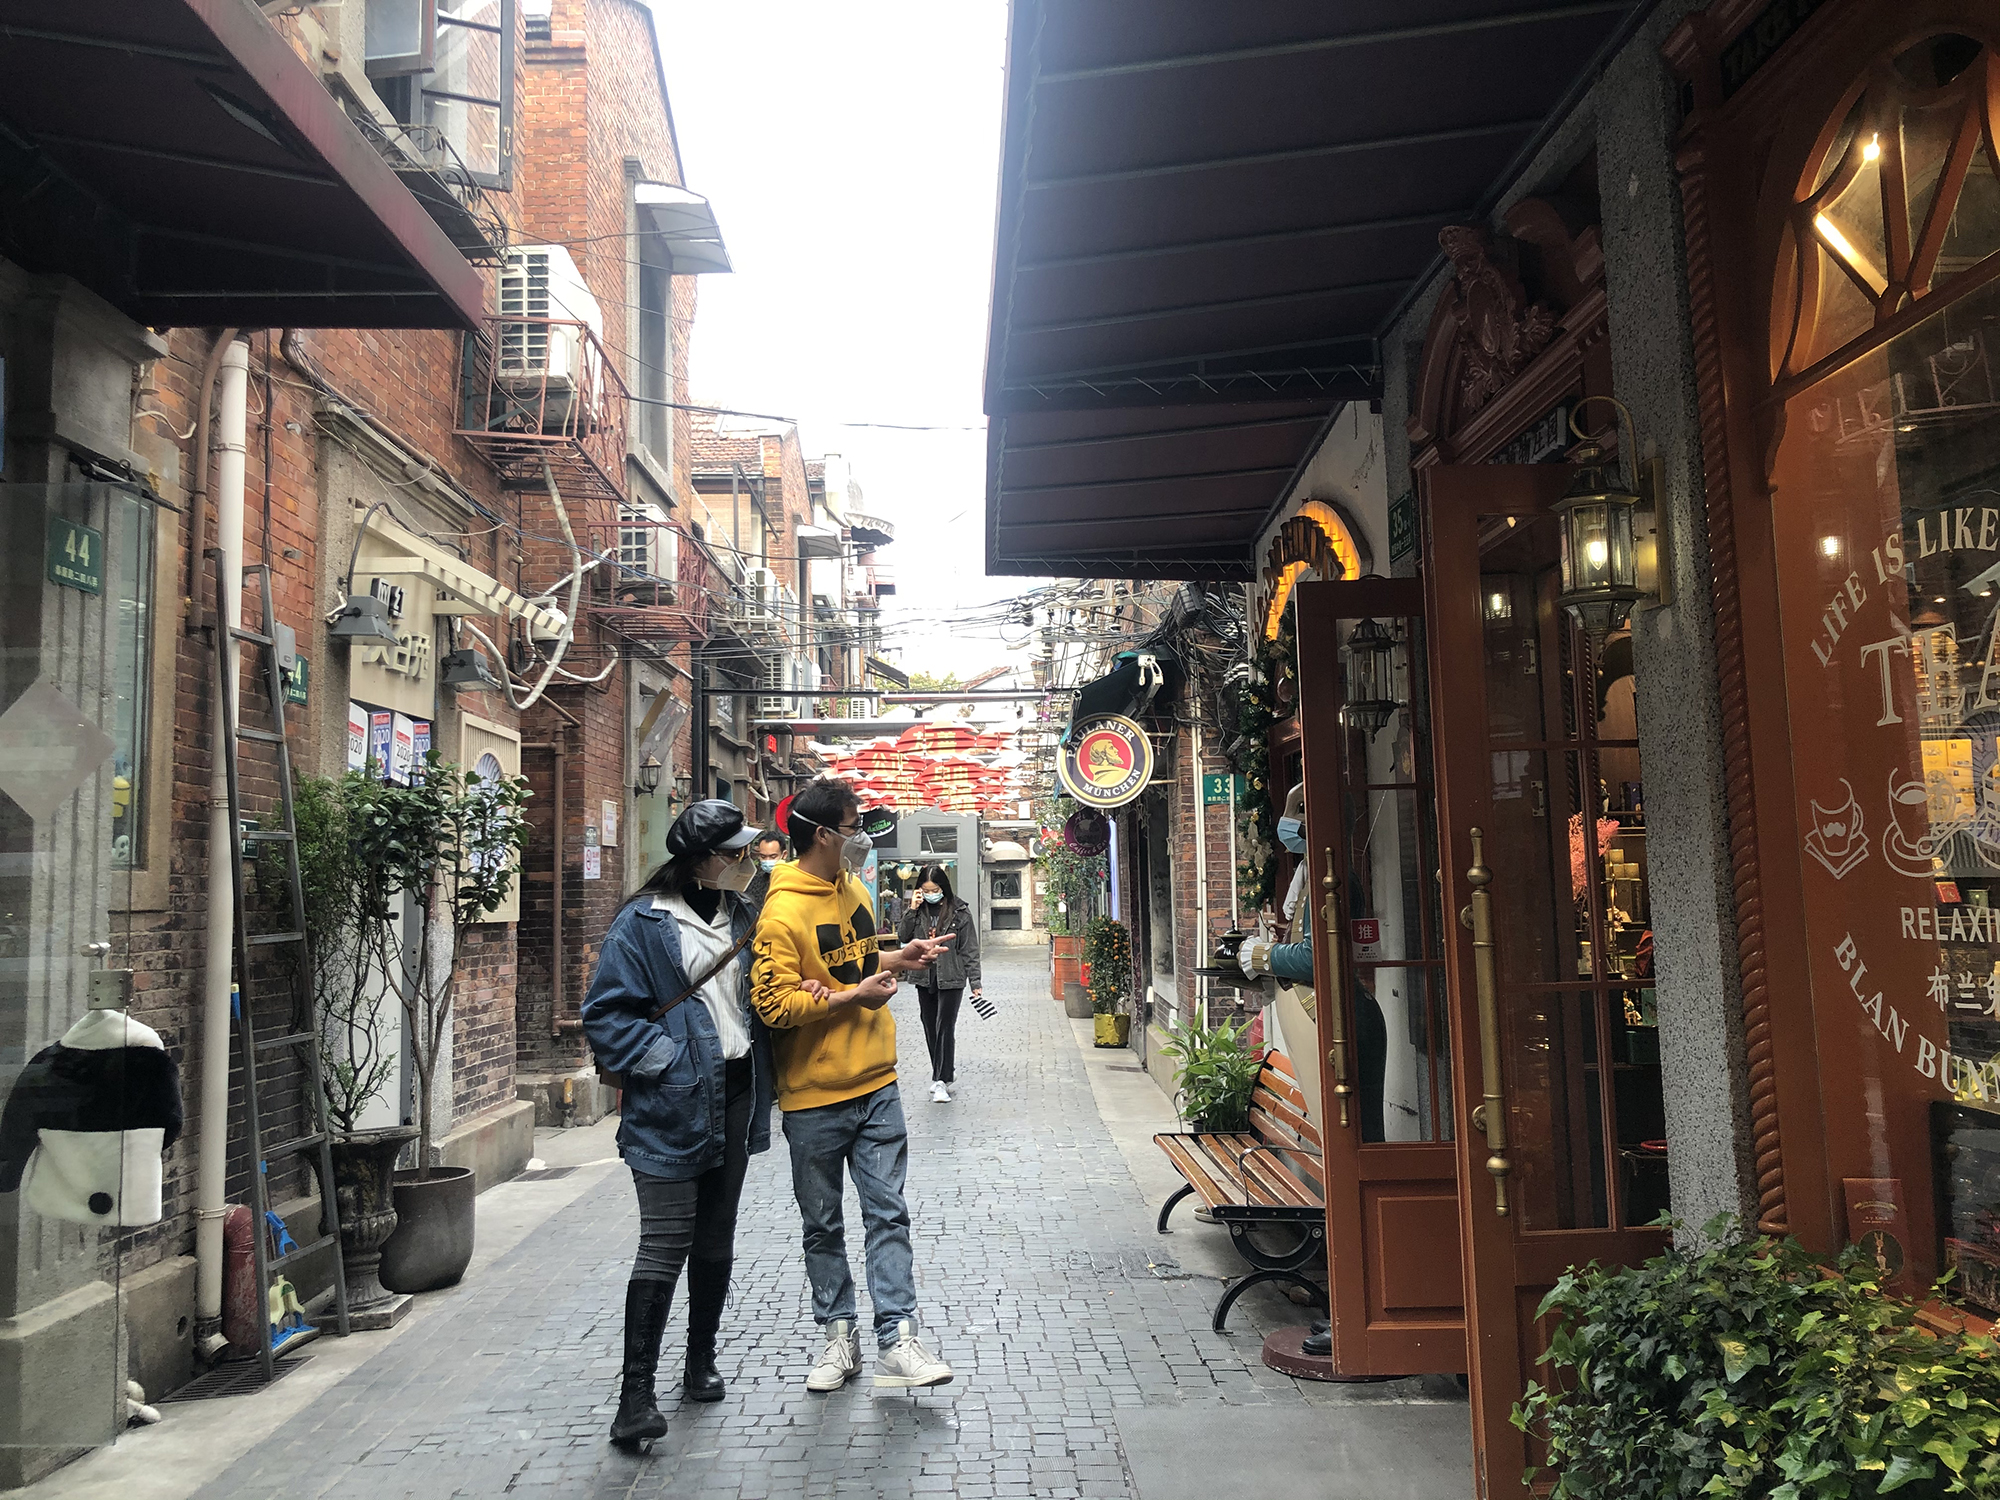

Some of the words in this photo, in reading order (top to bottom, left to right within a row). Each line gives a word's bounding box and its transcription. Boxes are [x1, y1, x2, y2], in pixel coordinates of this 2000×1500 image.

[65, 529, 90, 567] 44
[1811, 571, 1867, 668] LIFE
[1872, 533, 1904, 586] IS
[1917, 507, 2000, 559] LIKE
[1066, 720, 1136, 759] PAULANER
[1358, 924, 1374, 940] 推
[1900, 906, 2000, 943] RELAXI
[1833, 931, 1910, 1053] BLAN
